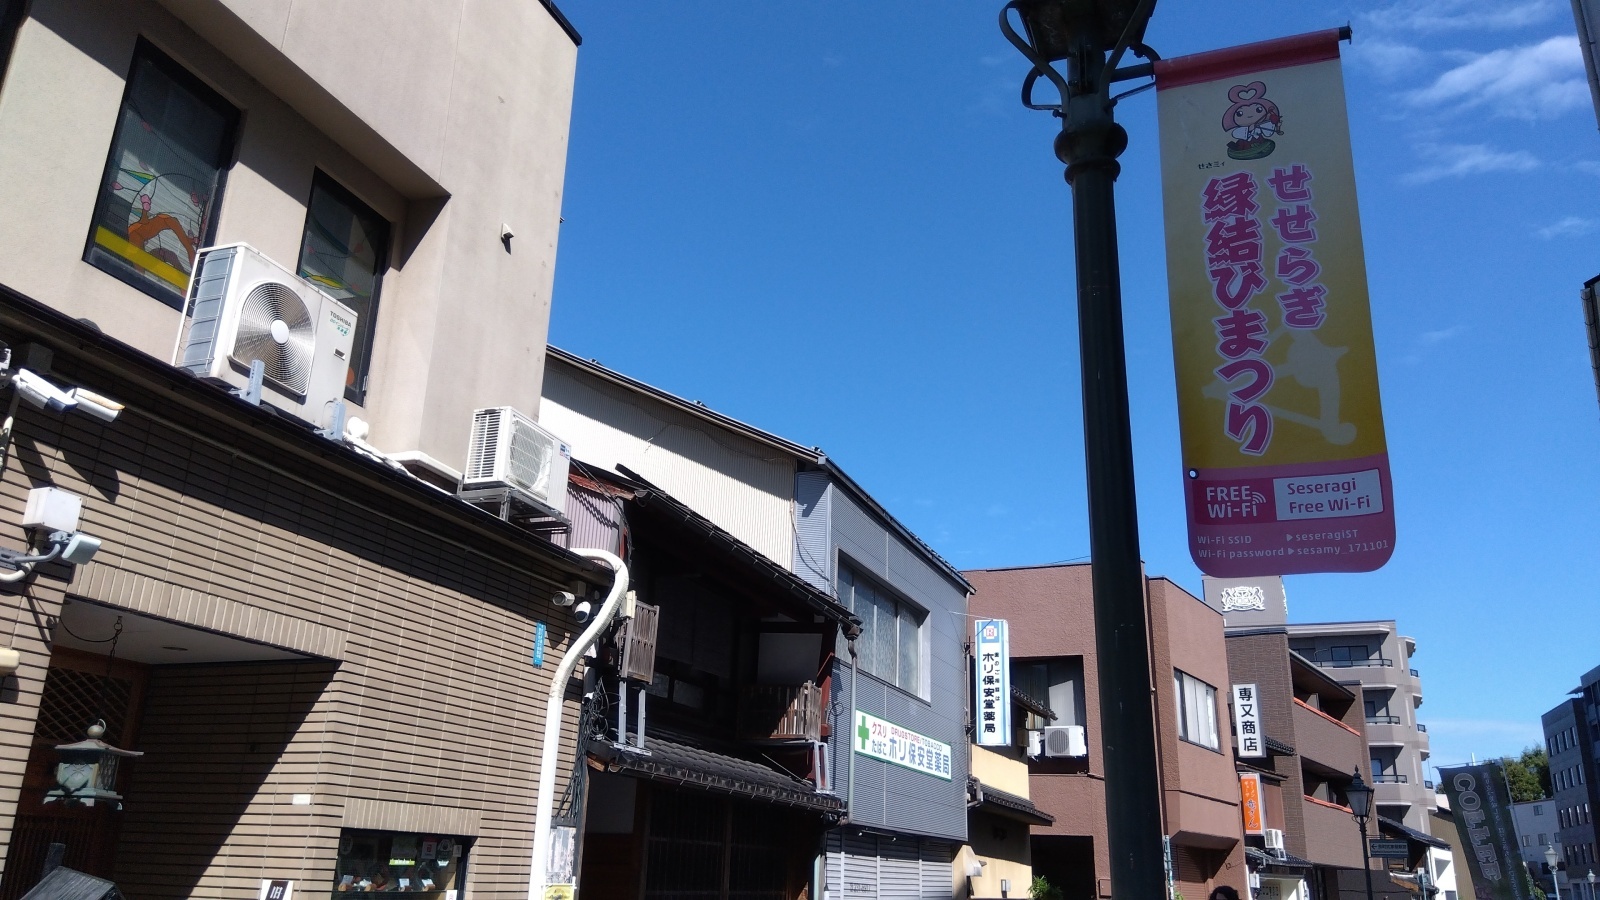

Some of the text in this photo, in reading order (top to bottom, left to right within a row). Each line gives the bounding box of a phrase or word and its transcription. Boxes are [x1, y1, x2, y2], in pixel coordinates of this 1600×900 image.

[1268, 165, 1326, 328] せせらぎ
[330, 311, 352, 327] TOSHIBA
[1202, 172, 1273, 455] 縁結びまつり
[1206, 486, 1251, 501] FREE
[1287, 478, 1357, 495] Seseragi
[1207, 502, 1258, 519] Wi-Fi
[1289, 495, 1371, 514] Free Wi-Fi
[1197, 529, 1359, 545] Wi-Fi SSID seseragiST
[1199, 540, 1389, 560] Wi-Fi password sesamy_171101
[982, 653, 996, 733] ホリ保安堂薬局
[1238, 687, 1258, 752] 専又商店
[872, 722, 887, 738] クスリ
[872, 737, 950, 775] たばこ ホリ保安堂薬局
